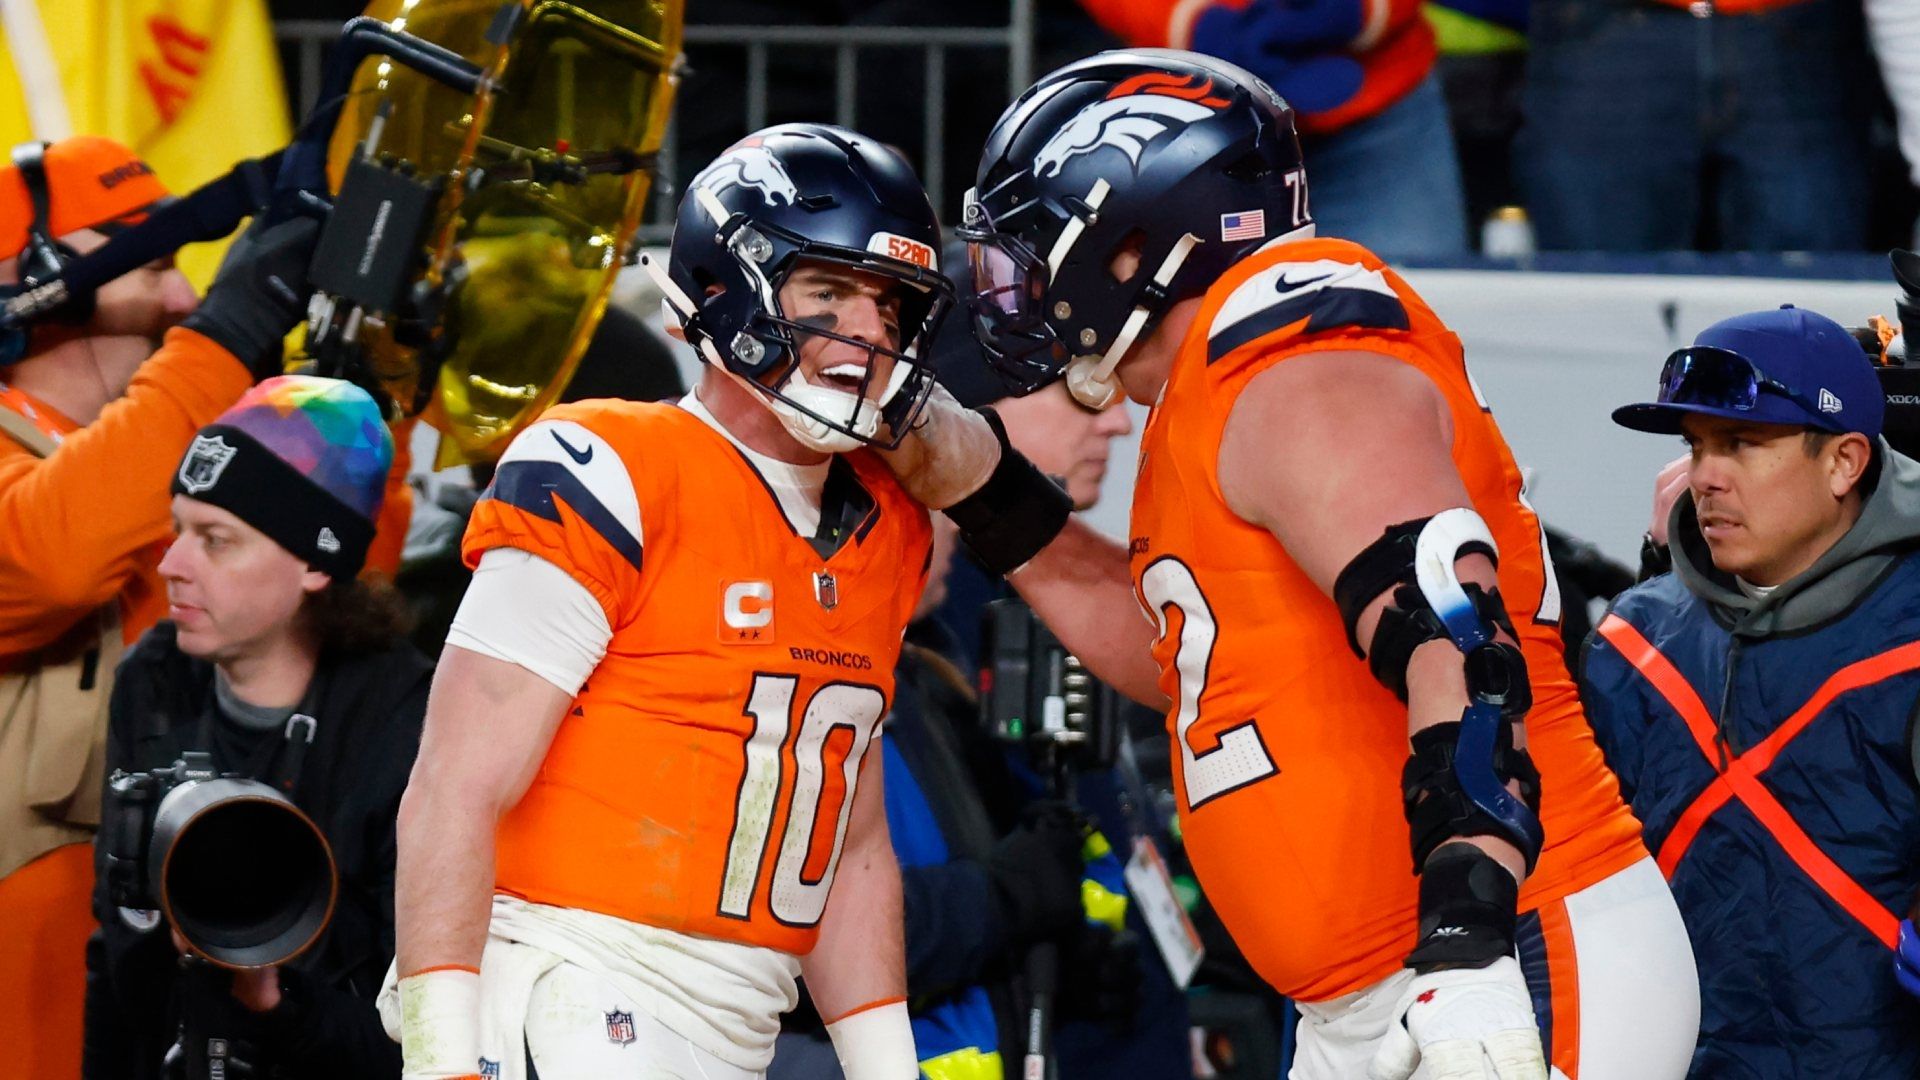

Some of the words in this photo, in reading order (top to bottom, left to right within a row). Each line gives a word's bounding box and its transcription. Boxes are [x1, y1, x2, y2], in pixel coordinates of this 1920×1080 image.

[887, 236, 931, 269] 5280
[1886, 394, 1920, 405] XDCA
[724, 582, 774, 629] C
[789, 647, 872, 670] BRONCOS
[717, 670, 887, 928] 10
